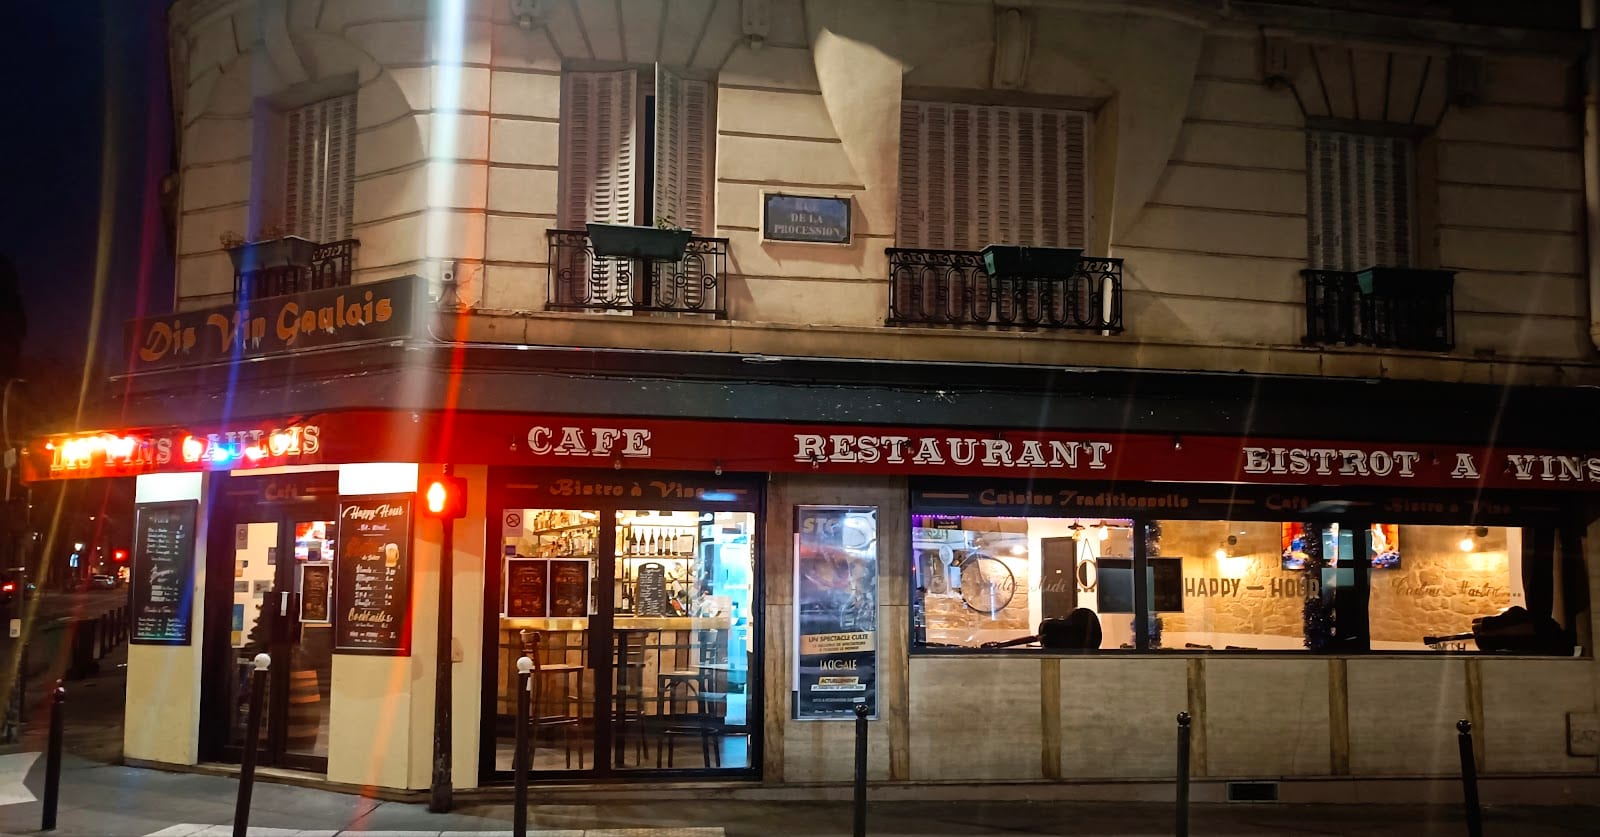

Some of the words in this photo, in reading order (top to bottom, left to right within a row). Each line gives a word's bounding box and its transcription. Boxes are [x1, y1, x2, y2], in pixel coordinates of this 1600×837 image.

[791, 213, 806, 223] DE
[809, 214, 823, 224] LA
[774, 224, 840, 237] PROCESSION
[139, 325, 196, 361] Dis
[207, 310, 265, 353] Vin
[276, 290, 393, 343] Gaulois
[527, 425, 652, 458] CAFE
[793, 434, 1113, 469] RESTAURANT
[1243, 447, 1420, 478] BISTROT
[1451, 452, 1482, 480] A
[1507, 453, 1600, 483] VINS
[550, 478, 623, 497] Bistro
[631, 482, 642, 497] à
[979, 489, 1053, 506] Cuisine
[1059, 490, 1189, 508] Traditionnelle
[342, 505, 377, 520] Happy
[375, 504, 403, 518] Hour
[1185, 577, 1241, 597] HAPPY
[1271, 577, 1320, 598] HOUR
[348, 607, 385, 622] Cocktails
[820, 634, 850, 642] SPECTACLE
